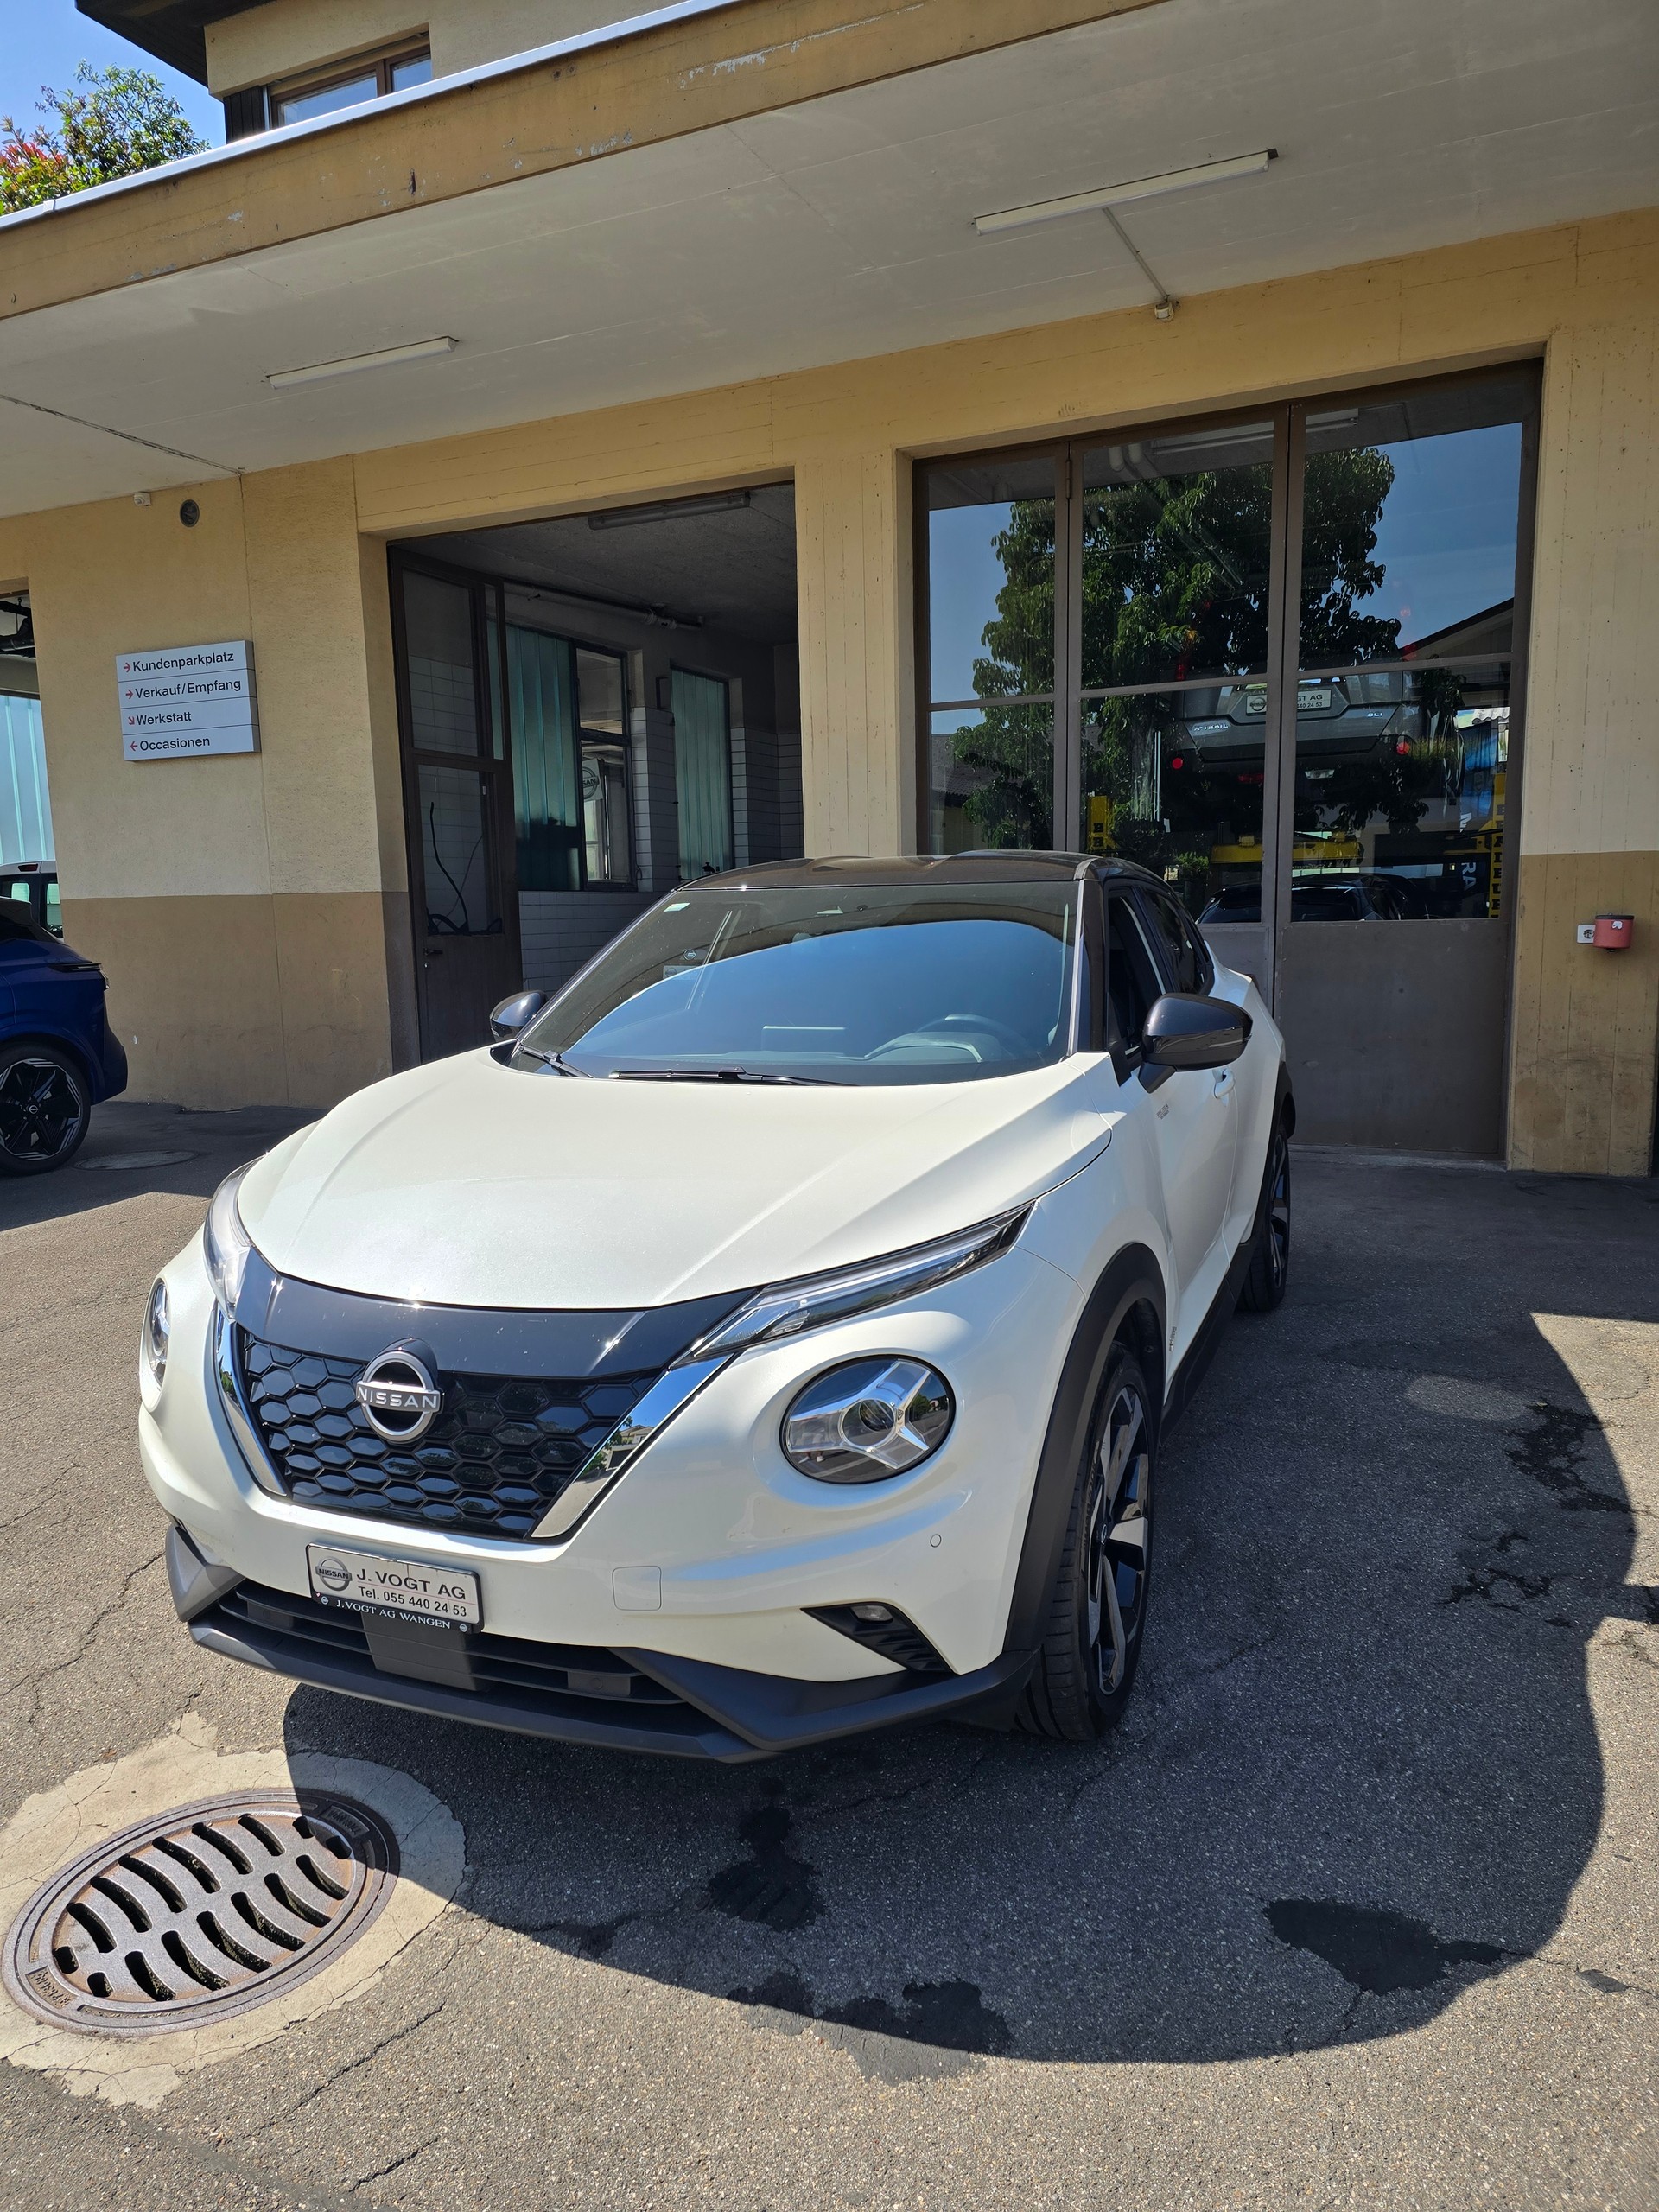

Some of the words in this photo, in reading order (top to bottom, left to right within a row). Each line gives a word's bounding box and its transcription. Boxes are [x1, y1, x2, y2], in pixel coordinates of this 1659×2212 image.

[132, 652, 234, 672] Kundenparkplatz
[135, 679, 241, 699] Verkauf/Empfang
[136, 711, 192, 726] Werkstatt
[139, 737, 211, 751] Occasionen
[356, 1386, 437, 1408] NISSAN
[318, 1568, 349, 1580] NISSAN
[356, 1568, 372, 1581] J.
[375, 1571, 431, 1592] VOGT
[437, 1583, 467, 1600] AG
[358, 1586, 380, 1599] Tel.
[383, 1591, 405, 1604] 055
[408, 1596, 430, 1610] 440
[434, 1600, 449, 1613] 24
[452, 1605, 467, 1617] 53
[379, 1609, 396, 1618] AG
[399, 1611, 451, 1629] WANGEN
